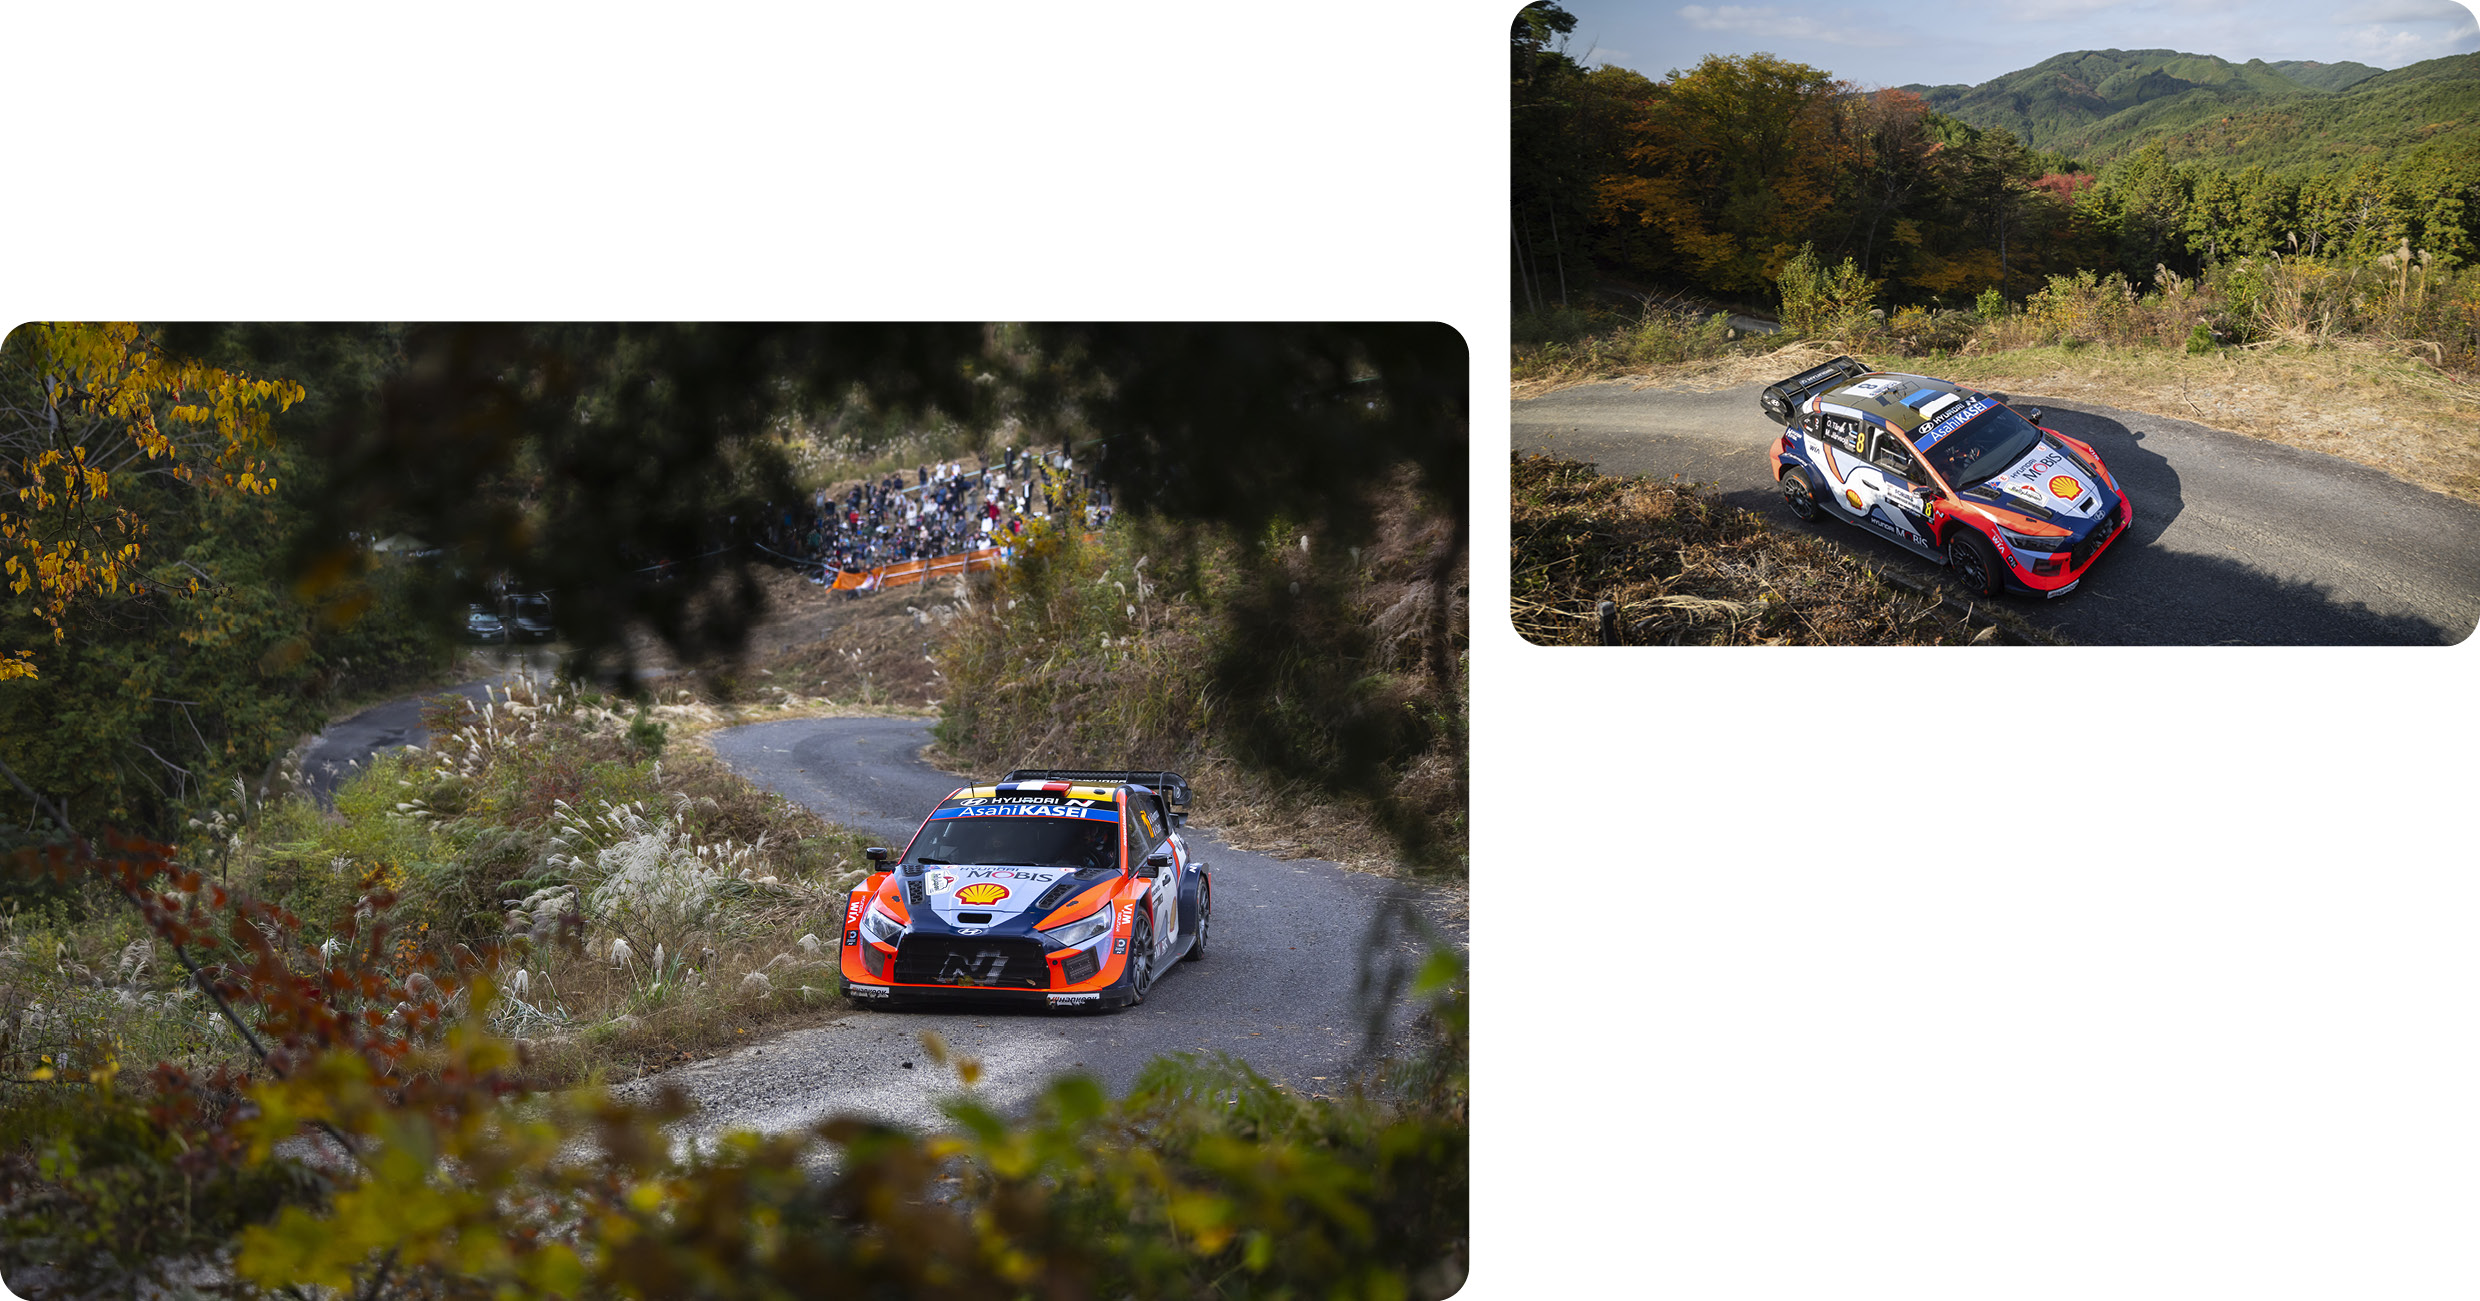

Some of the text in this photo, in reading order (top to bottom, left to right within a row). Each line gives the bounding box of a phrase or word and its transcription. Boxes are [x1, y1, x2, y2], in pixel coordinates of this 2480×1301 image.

[1931, 402, 1988, 442] AsahiKASEI
[1932, 403, 1965, 424] HYUNDAI
[1856, 432, 1865, 453] 8
[2010, 459, 2037, 479] HYUNDAI
[2022, 453, 2062, 481] MOBIS
[1925, 502, 1932, 517] 8
[991, 797, 1058, 805] HYUNDAI
[958, 805, 1088, 819] AsahiKASEI
[967, 870, 1054, 883] MOBIS
